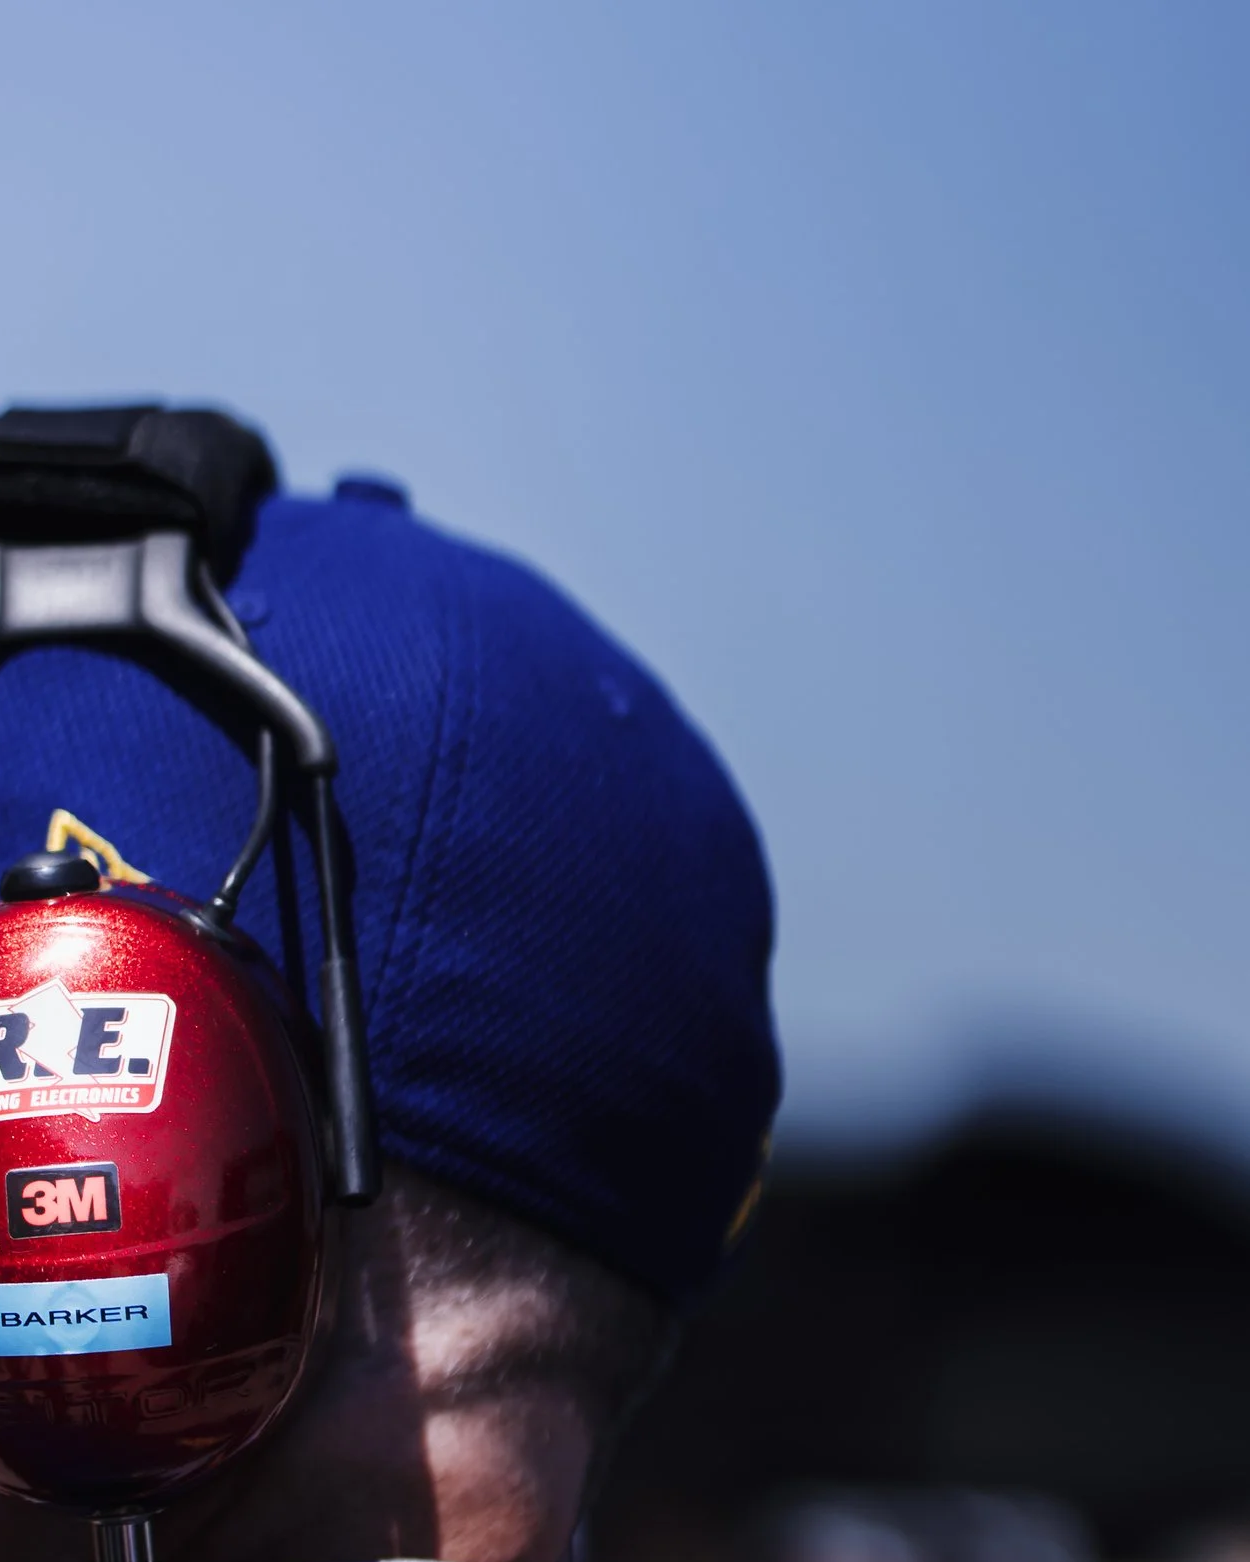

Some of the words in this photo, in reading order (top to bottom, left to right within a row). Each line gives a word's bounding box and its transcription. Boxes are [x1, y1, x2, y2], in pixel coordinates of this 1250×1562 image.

[30, 1087, 140, 1107] ELECTRONICS
[21, 1176, 108, 1226] 3M
[0, 1304, 149, 1328] BARKER
